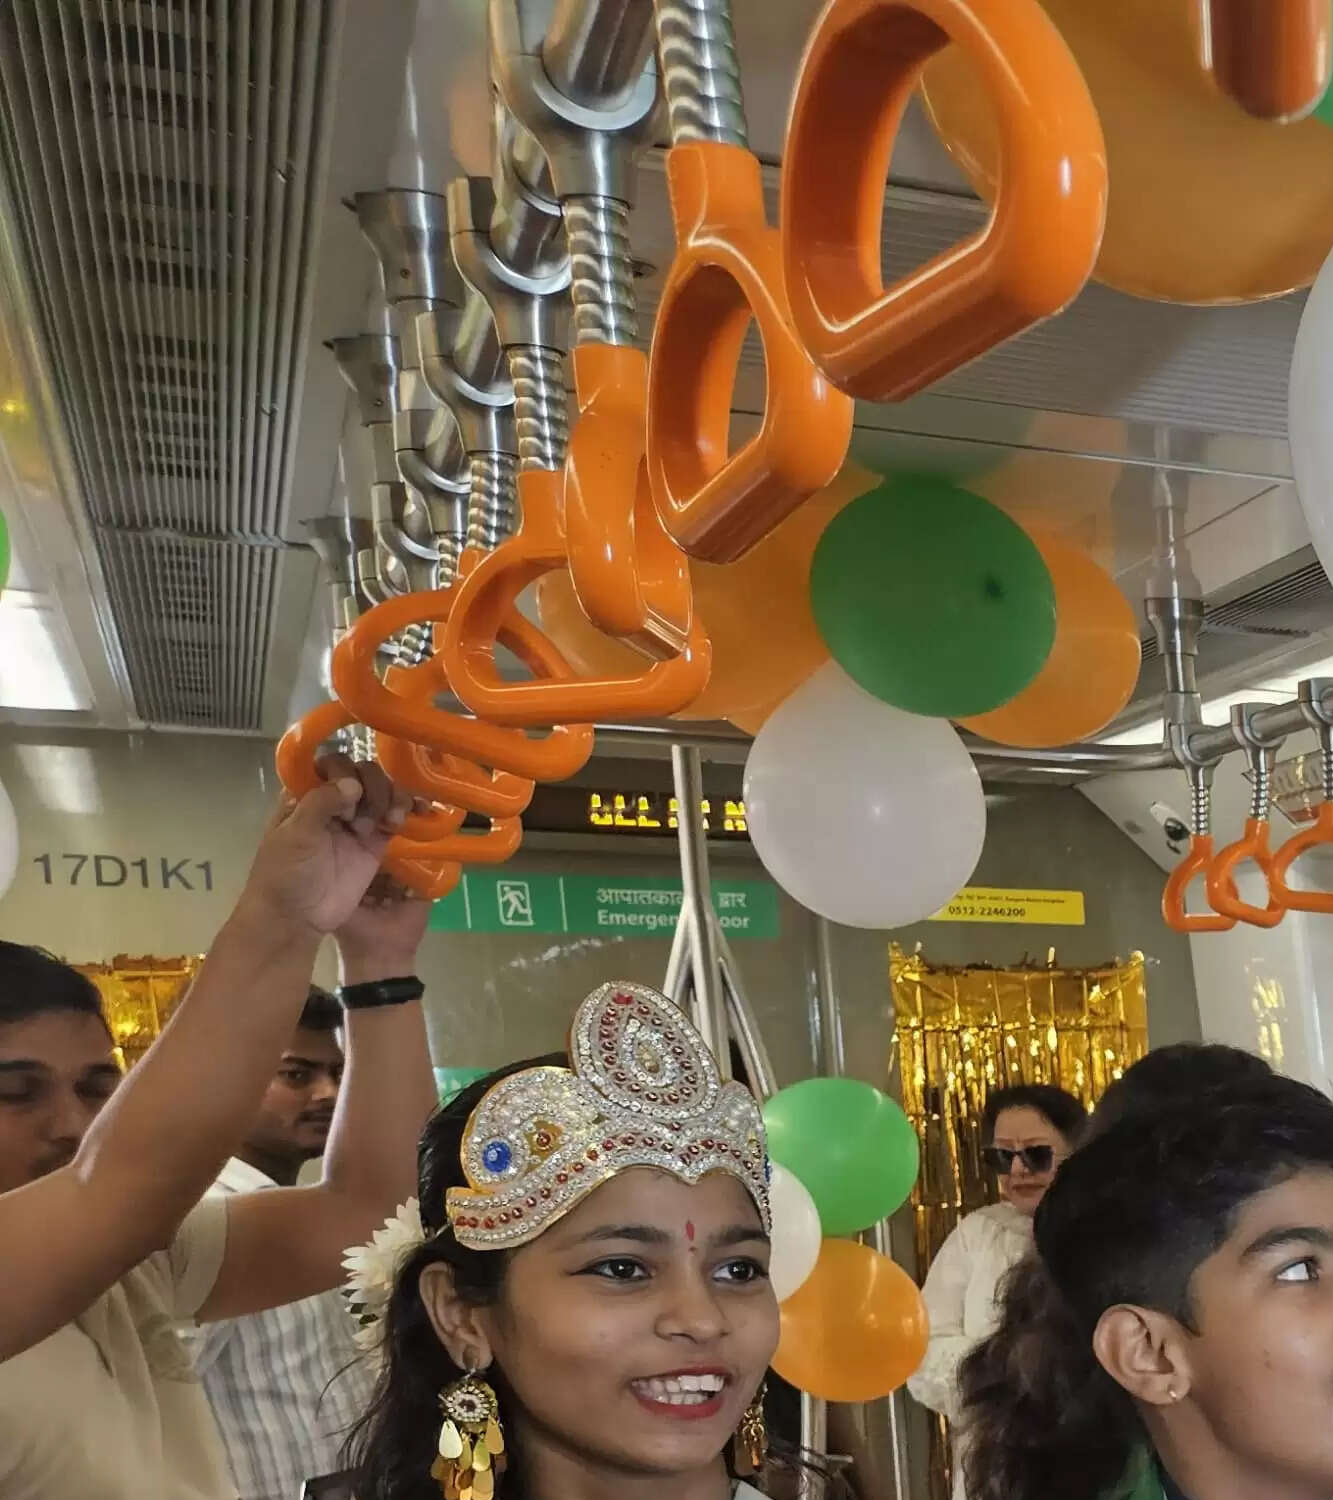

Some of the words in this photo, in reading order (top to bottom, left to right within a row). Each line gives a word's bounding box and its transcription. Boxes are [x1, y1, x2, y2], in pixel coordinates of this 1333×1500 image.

[33, 853, 213, 891] 17D1K1
[597, 909, 681, 931] Emergen
[719, 915, 750, 929] oor
